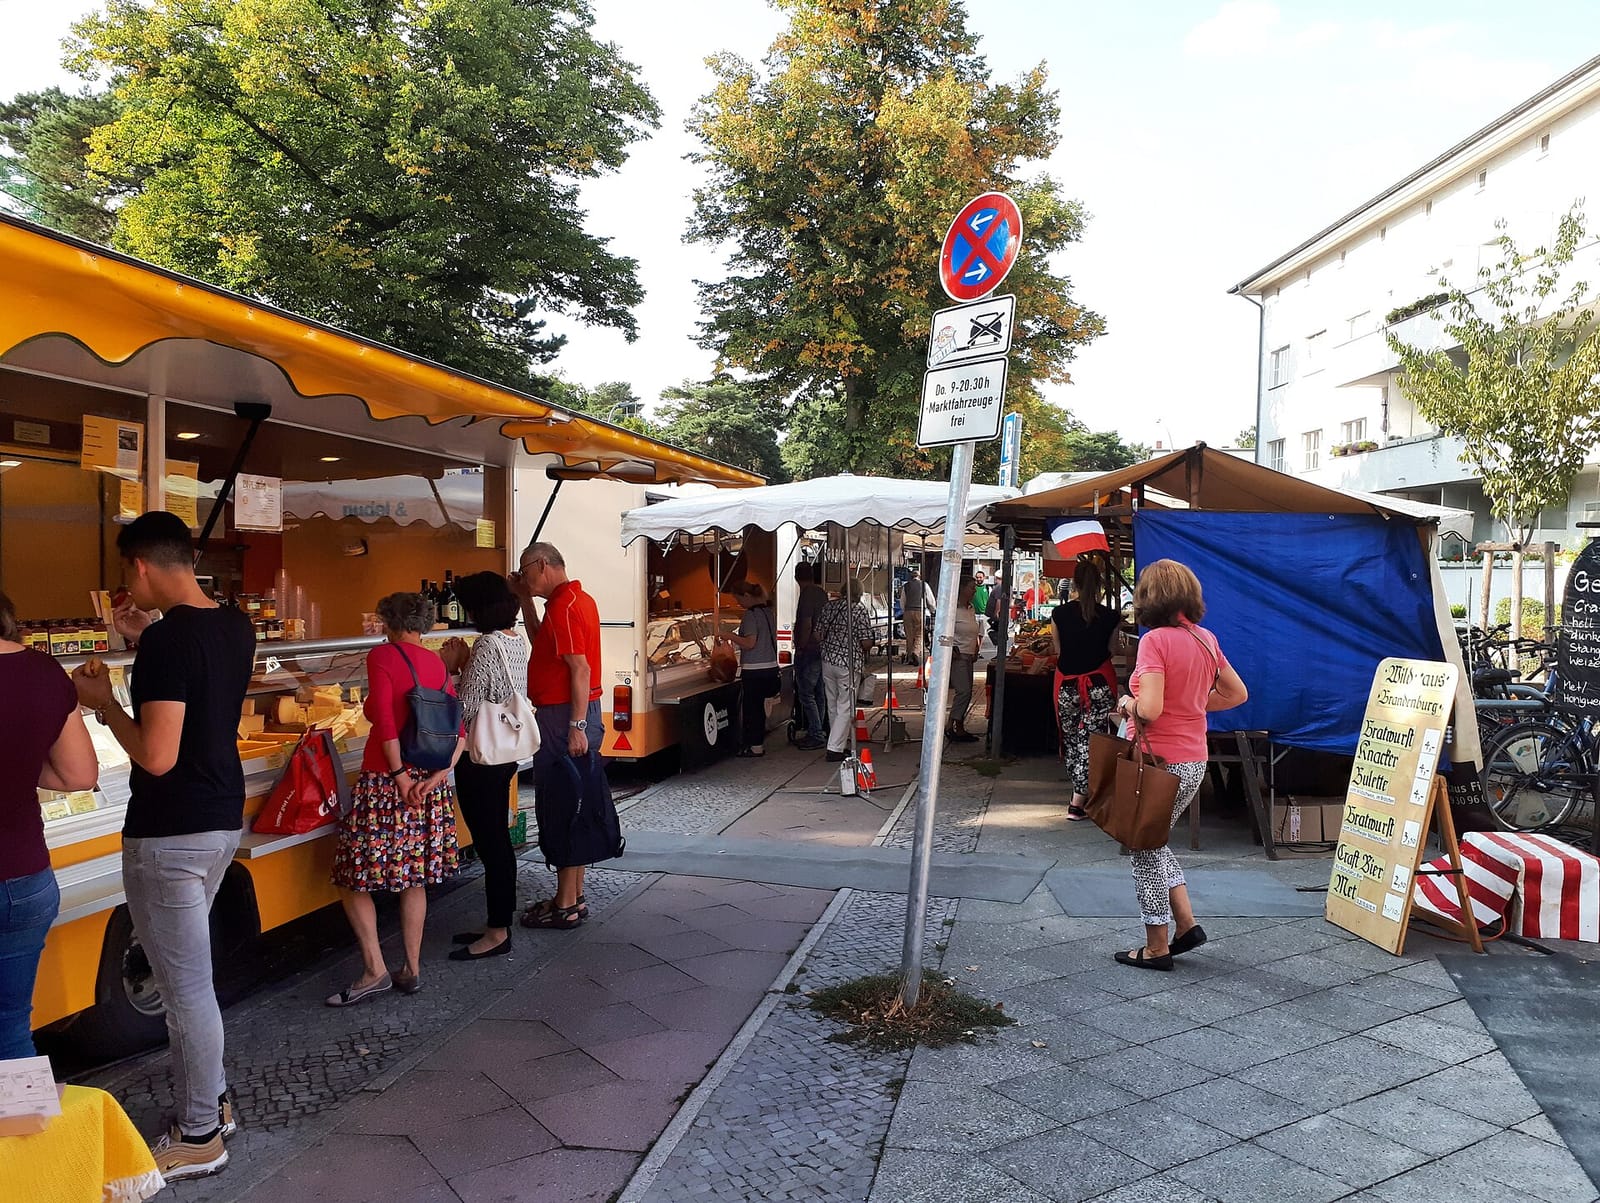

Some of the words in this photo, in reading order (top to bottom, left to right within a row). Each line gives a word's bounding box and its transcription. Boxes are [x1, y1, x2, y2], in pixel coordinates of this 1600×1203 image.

[936, 383, 947, 396] Do.
[950, 413, 966, 427] frei
[1574, 599, 1600, 613] Cra
[1572, 616, 1594, 629] hell
[1359, 853, 1384, 879] Bier
[1334, 874, 1357, 899] Met
